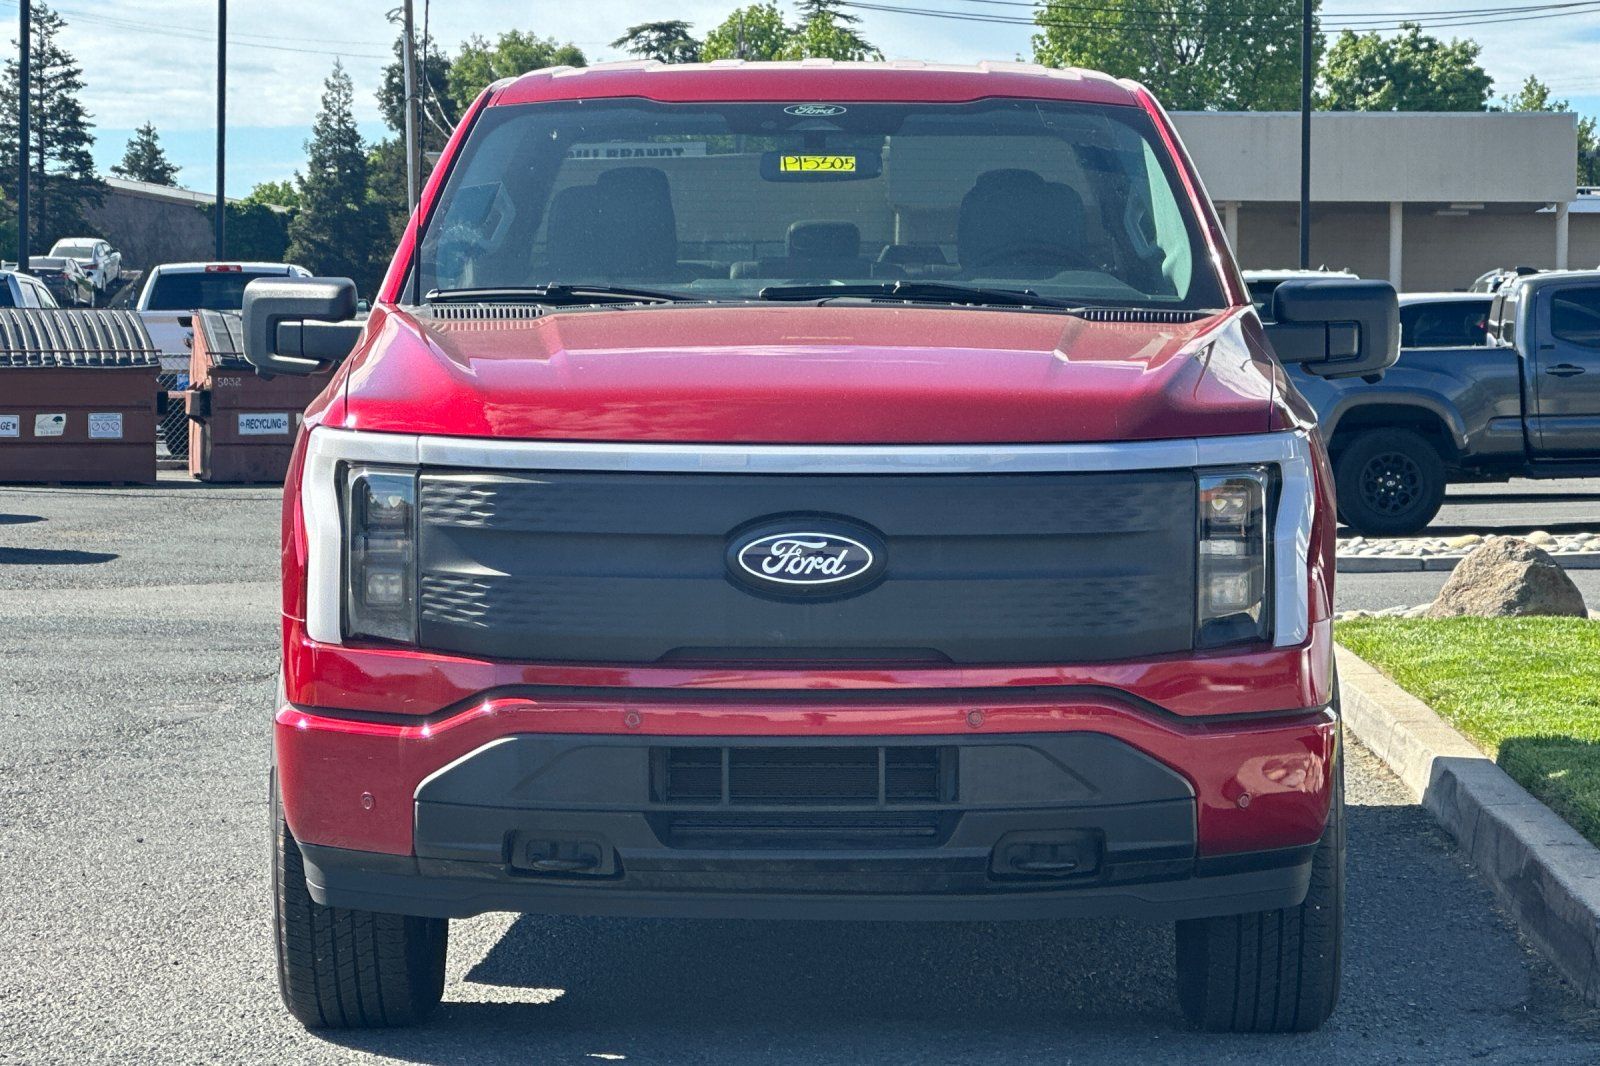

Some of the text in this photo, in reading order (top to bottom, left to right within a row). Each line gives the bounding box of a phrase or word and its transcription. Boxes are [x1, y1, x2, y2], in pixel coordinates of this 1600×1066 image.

[794, 104, 837, 114] Ford
[245, 418, 282, 430] RECYCLING
[761, 539, 849, 575] Ford
